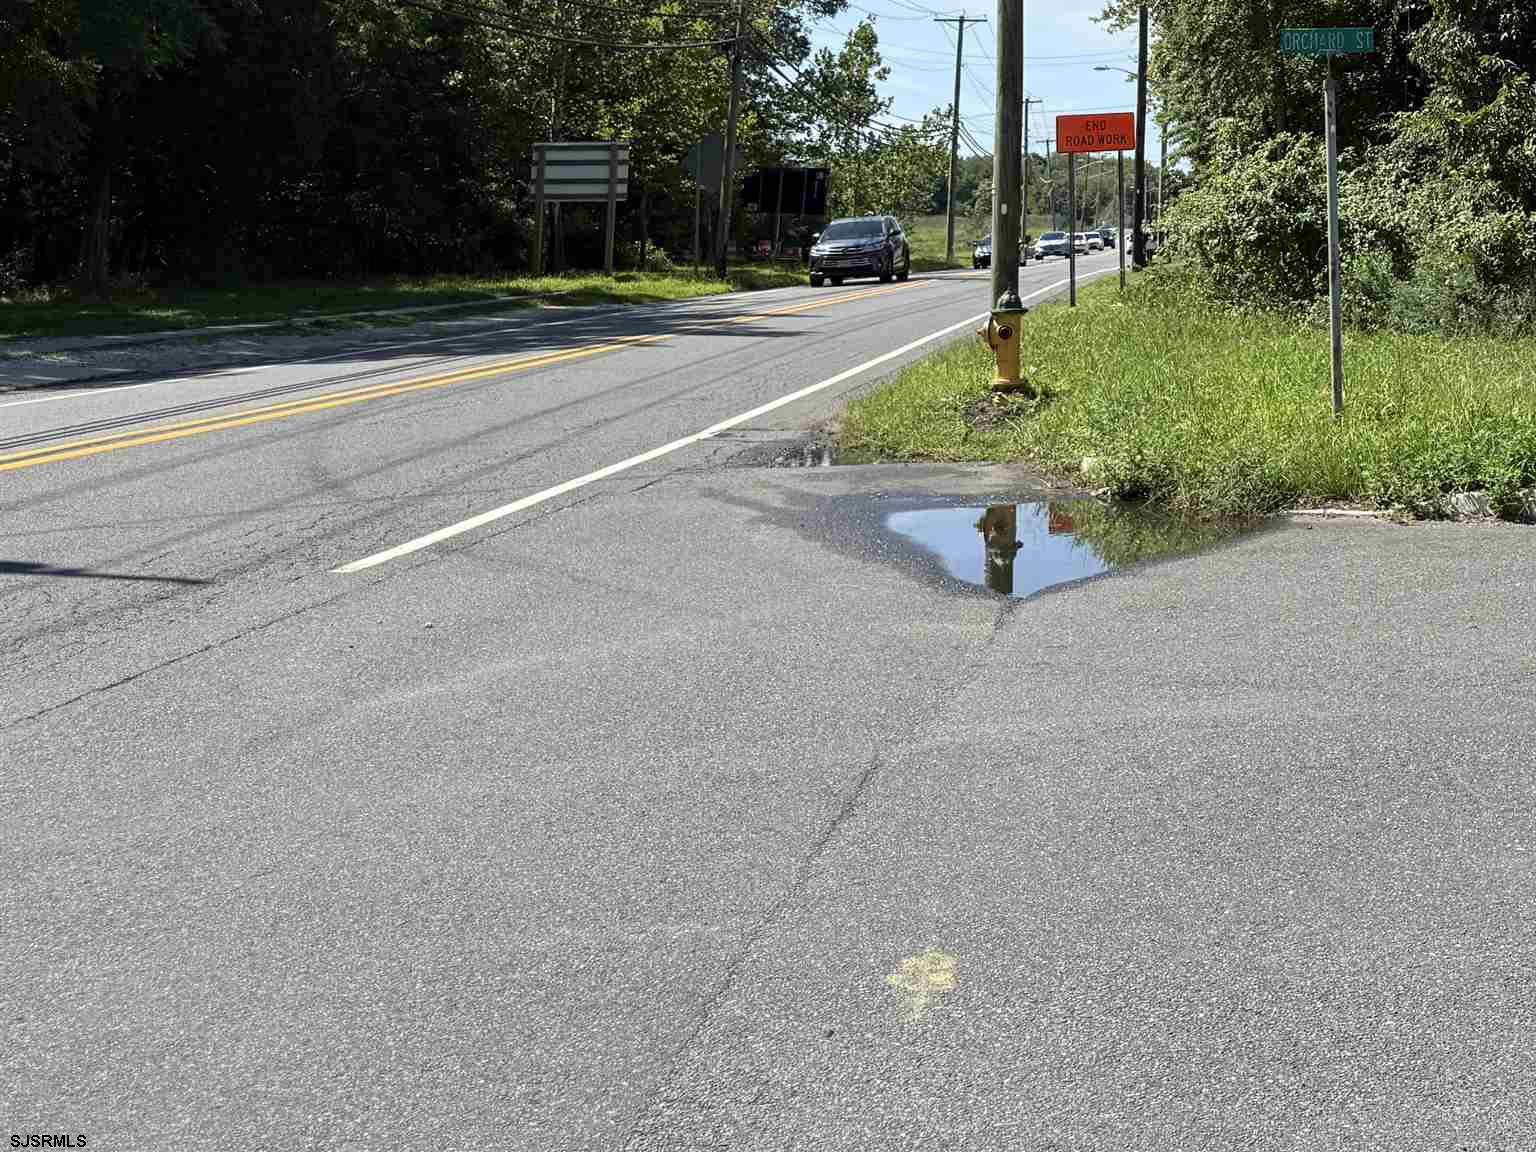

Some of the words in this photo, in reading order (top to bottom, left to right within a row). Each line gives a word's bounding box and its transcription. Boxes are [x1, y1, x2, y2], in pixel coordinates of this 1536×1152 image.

[1284, 32, 1344, 49] ORCHARD
[1356, 31, 1372, 49] ST
[1086, 120, 1106, 132] END
[1065, 134, 1095, 147] ROAD
[1097, 133, 1127, 145] WORK
